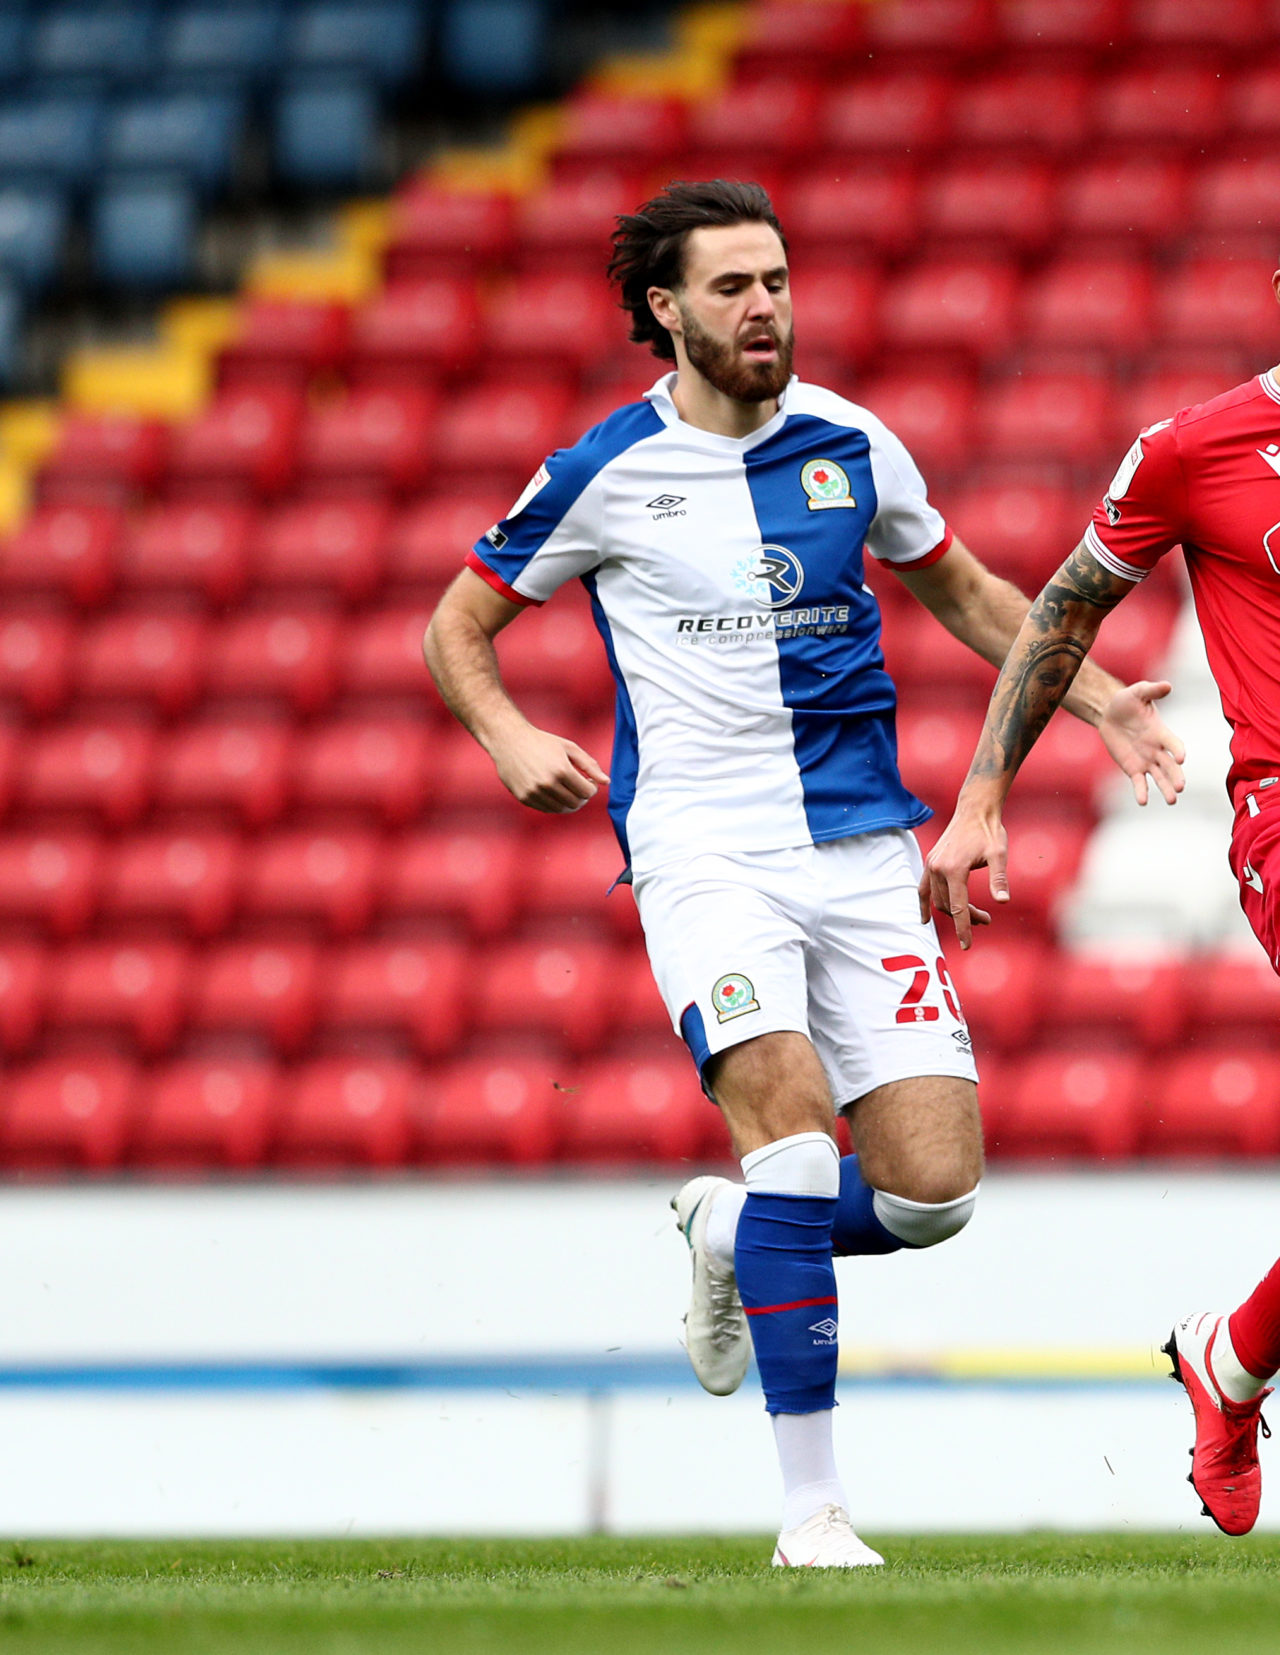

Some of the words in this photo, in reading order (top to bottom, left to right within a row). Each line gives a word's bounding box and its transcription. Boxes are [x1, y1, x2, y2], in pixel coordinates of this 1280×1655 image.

[652, 509, 687, 521] umbro
[677, 606, 849, 633] RECOVERITE
[675, 636, 699, 647] ice
